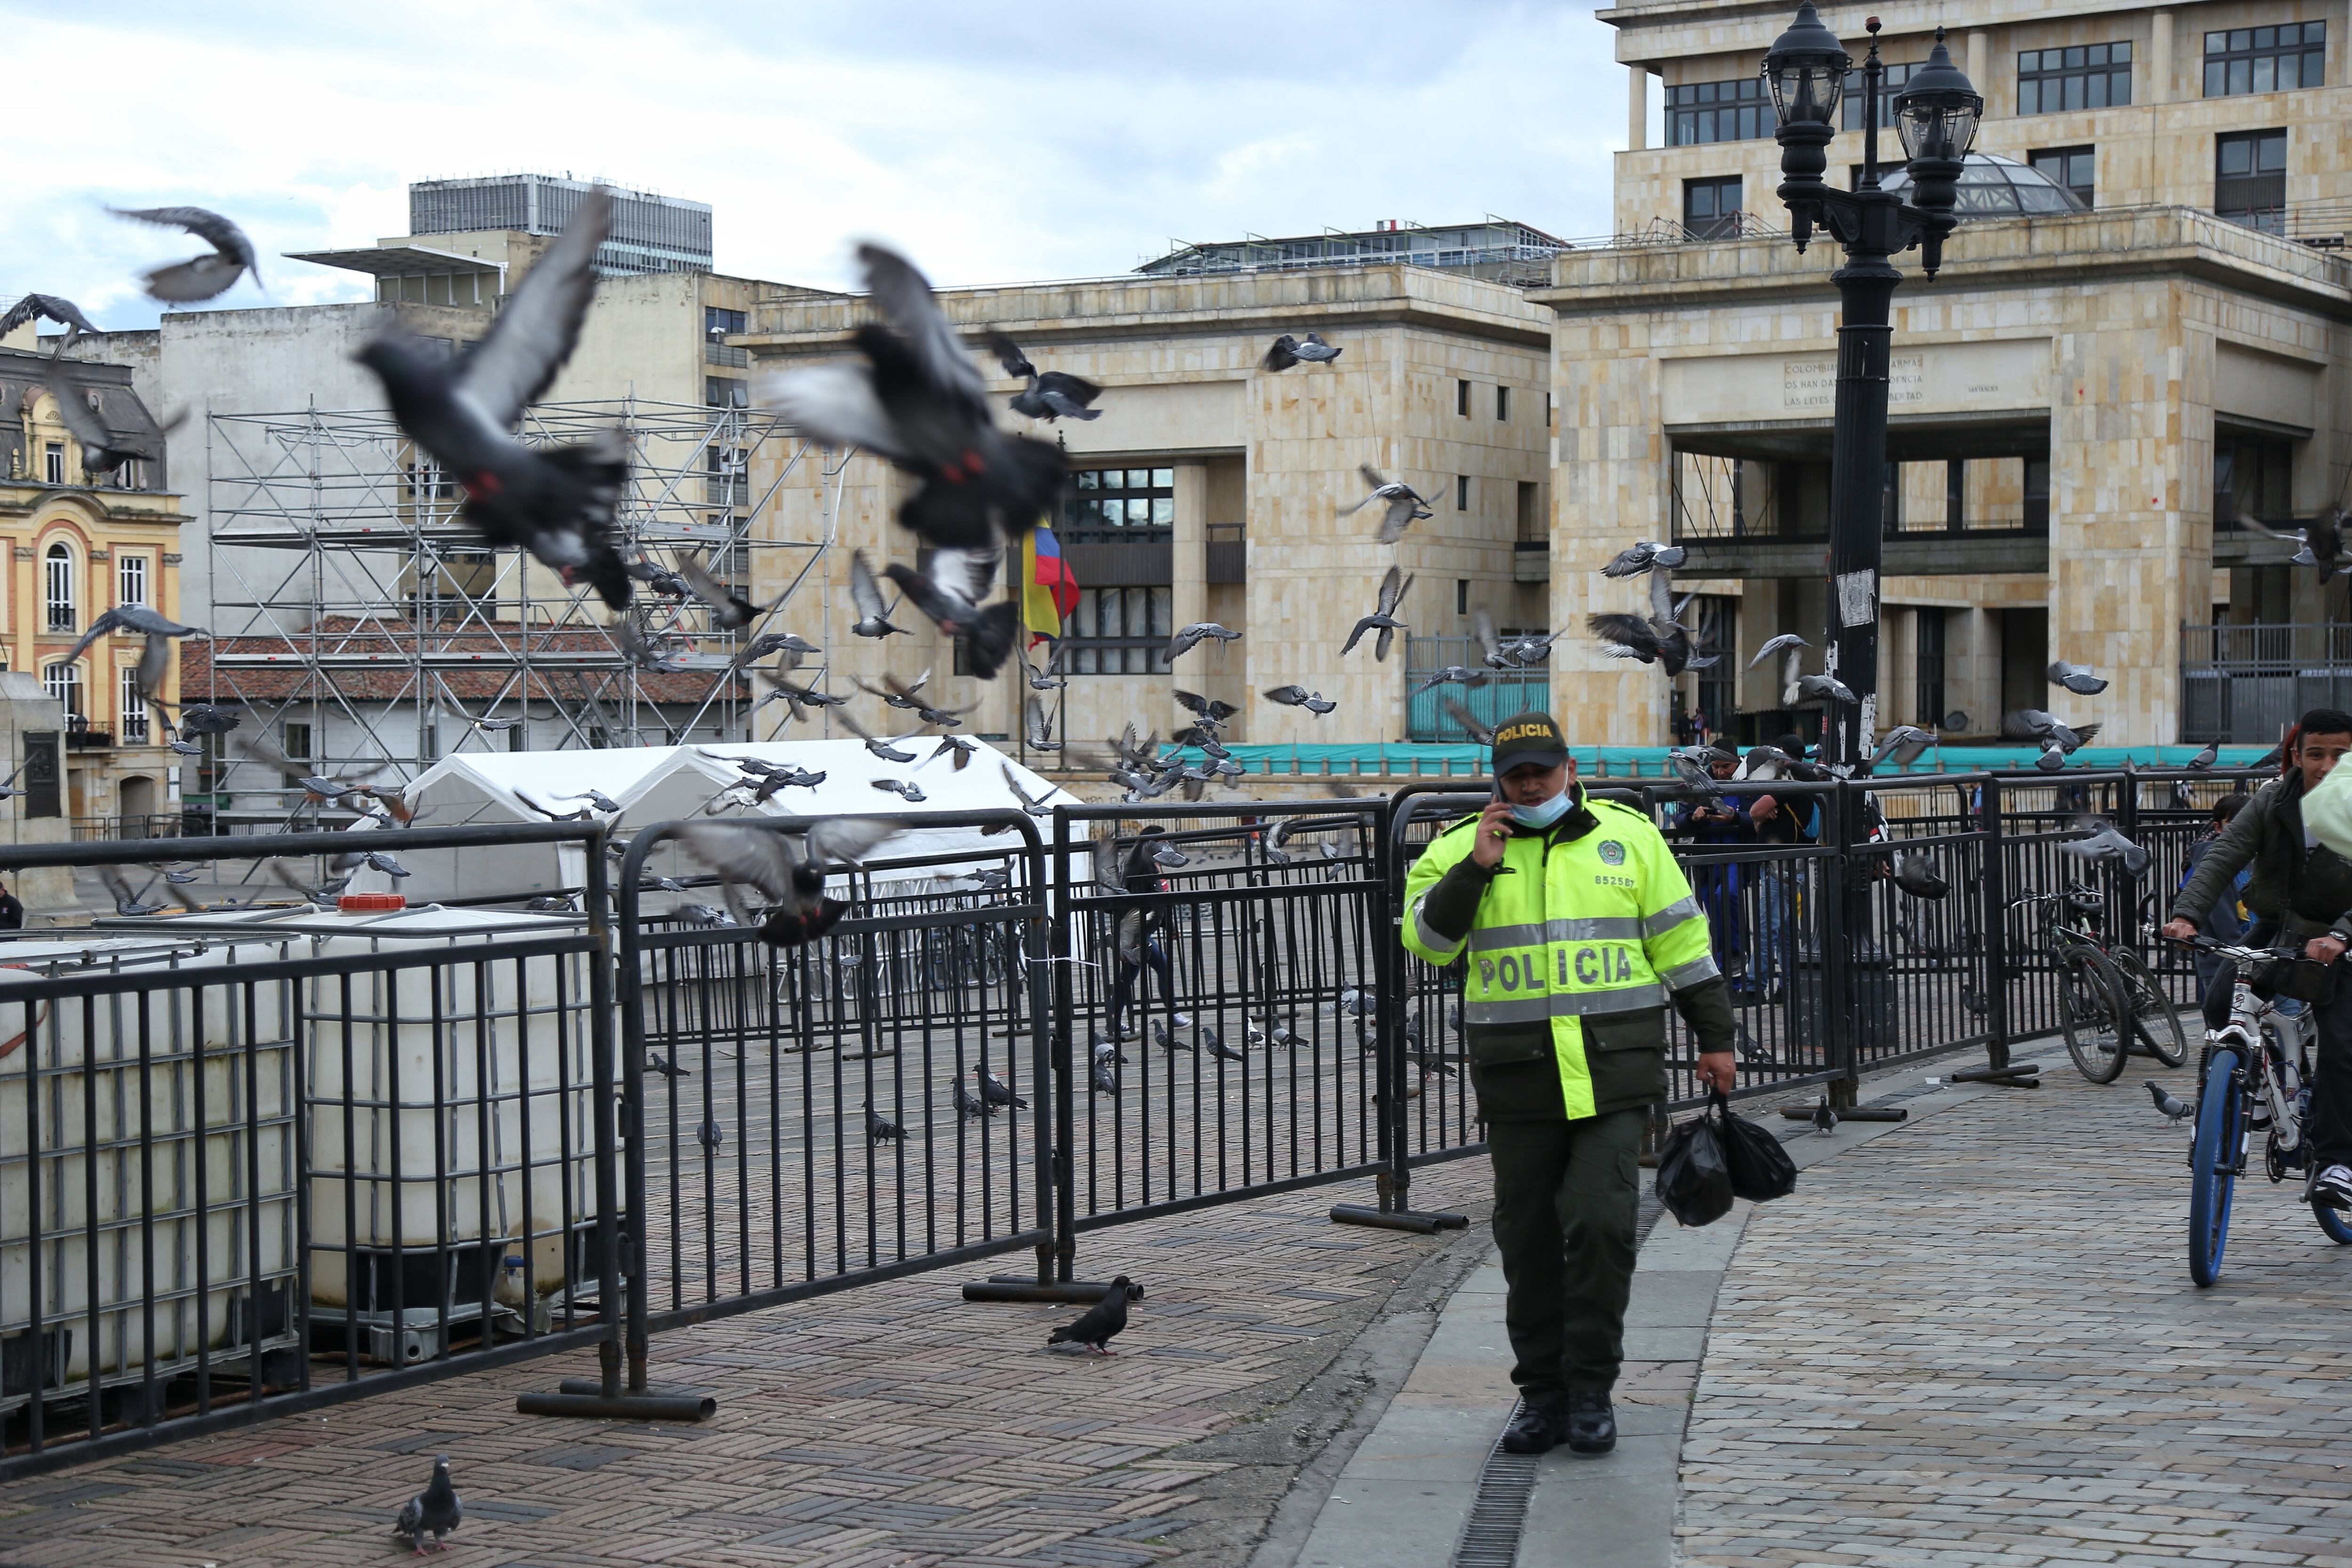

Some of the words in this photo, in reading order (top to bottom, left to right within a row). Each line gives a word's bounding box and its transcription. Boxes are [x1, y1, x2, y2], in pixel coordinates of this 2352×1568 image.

[1891, 358, 1923, 368] ARMAS
[1785, 381, 1797, 390] OS
[1801, 380, 1818, 389] HAN
[1821, 378, 1836, 388] DA
[1890, 375, 1923, 384] DENCIA
[1785, 397, 1801, 406] LAS
[1804, 395, 1829, 406] LEYES
[1889, 391, 1923, 401] BERTAD
[1496, 724, 1553, 746] POLICIA
[1595, 876, 1635, 889] 852587
[1478, 947, 1632, 994] POLICIA
